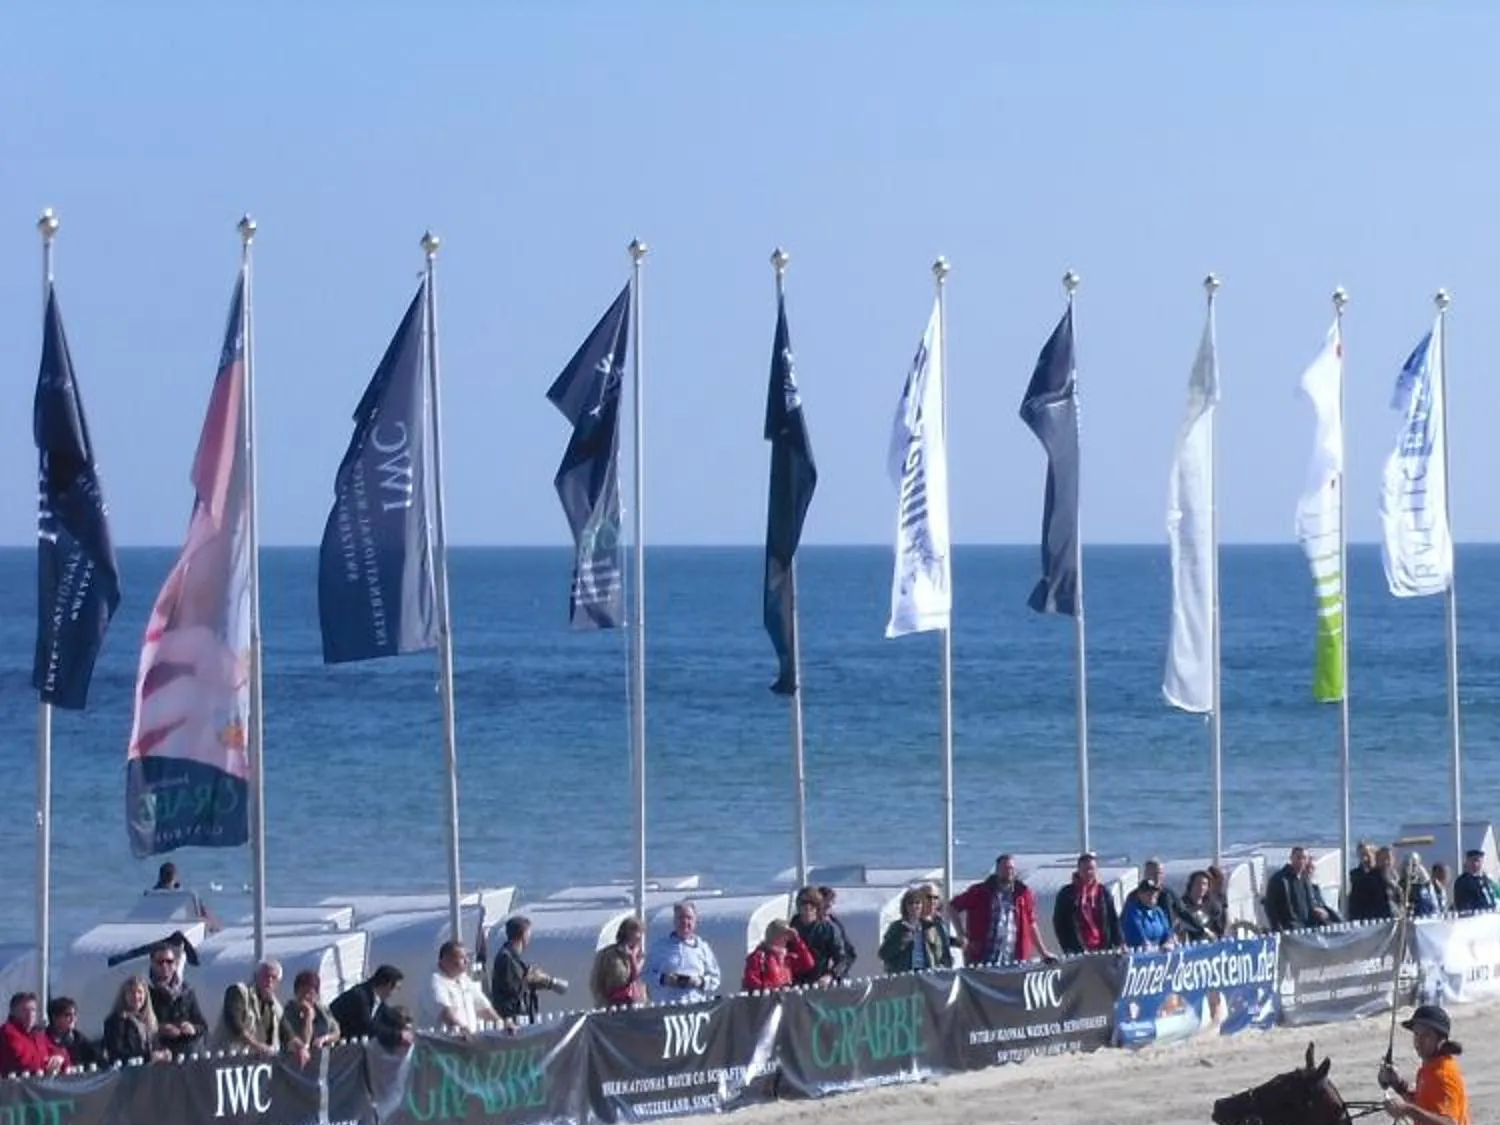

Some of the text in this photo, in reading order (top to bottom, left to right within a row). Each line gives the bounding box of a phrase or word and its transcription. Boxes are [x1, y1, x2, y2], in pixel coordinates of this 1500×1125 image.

[1023, 969, 1063, 1011] IWC
[661, 1011, 711, 1059] IWC
[214, 1064, 273, 1118] IWC
